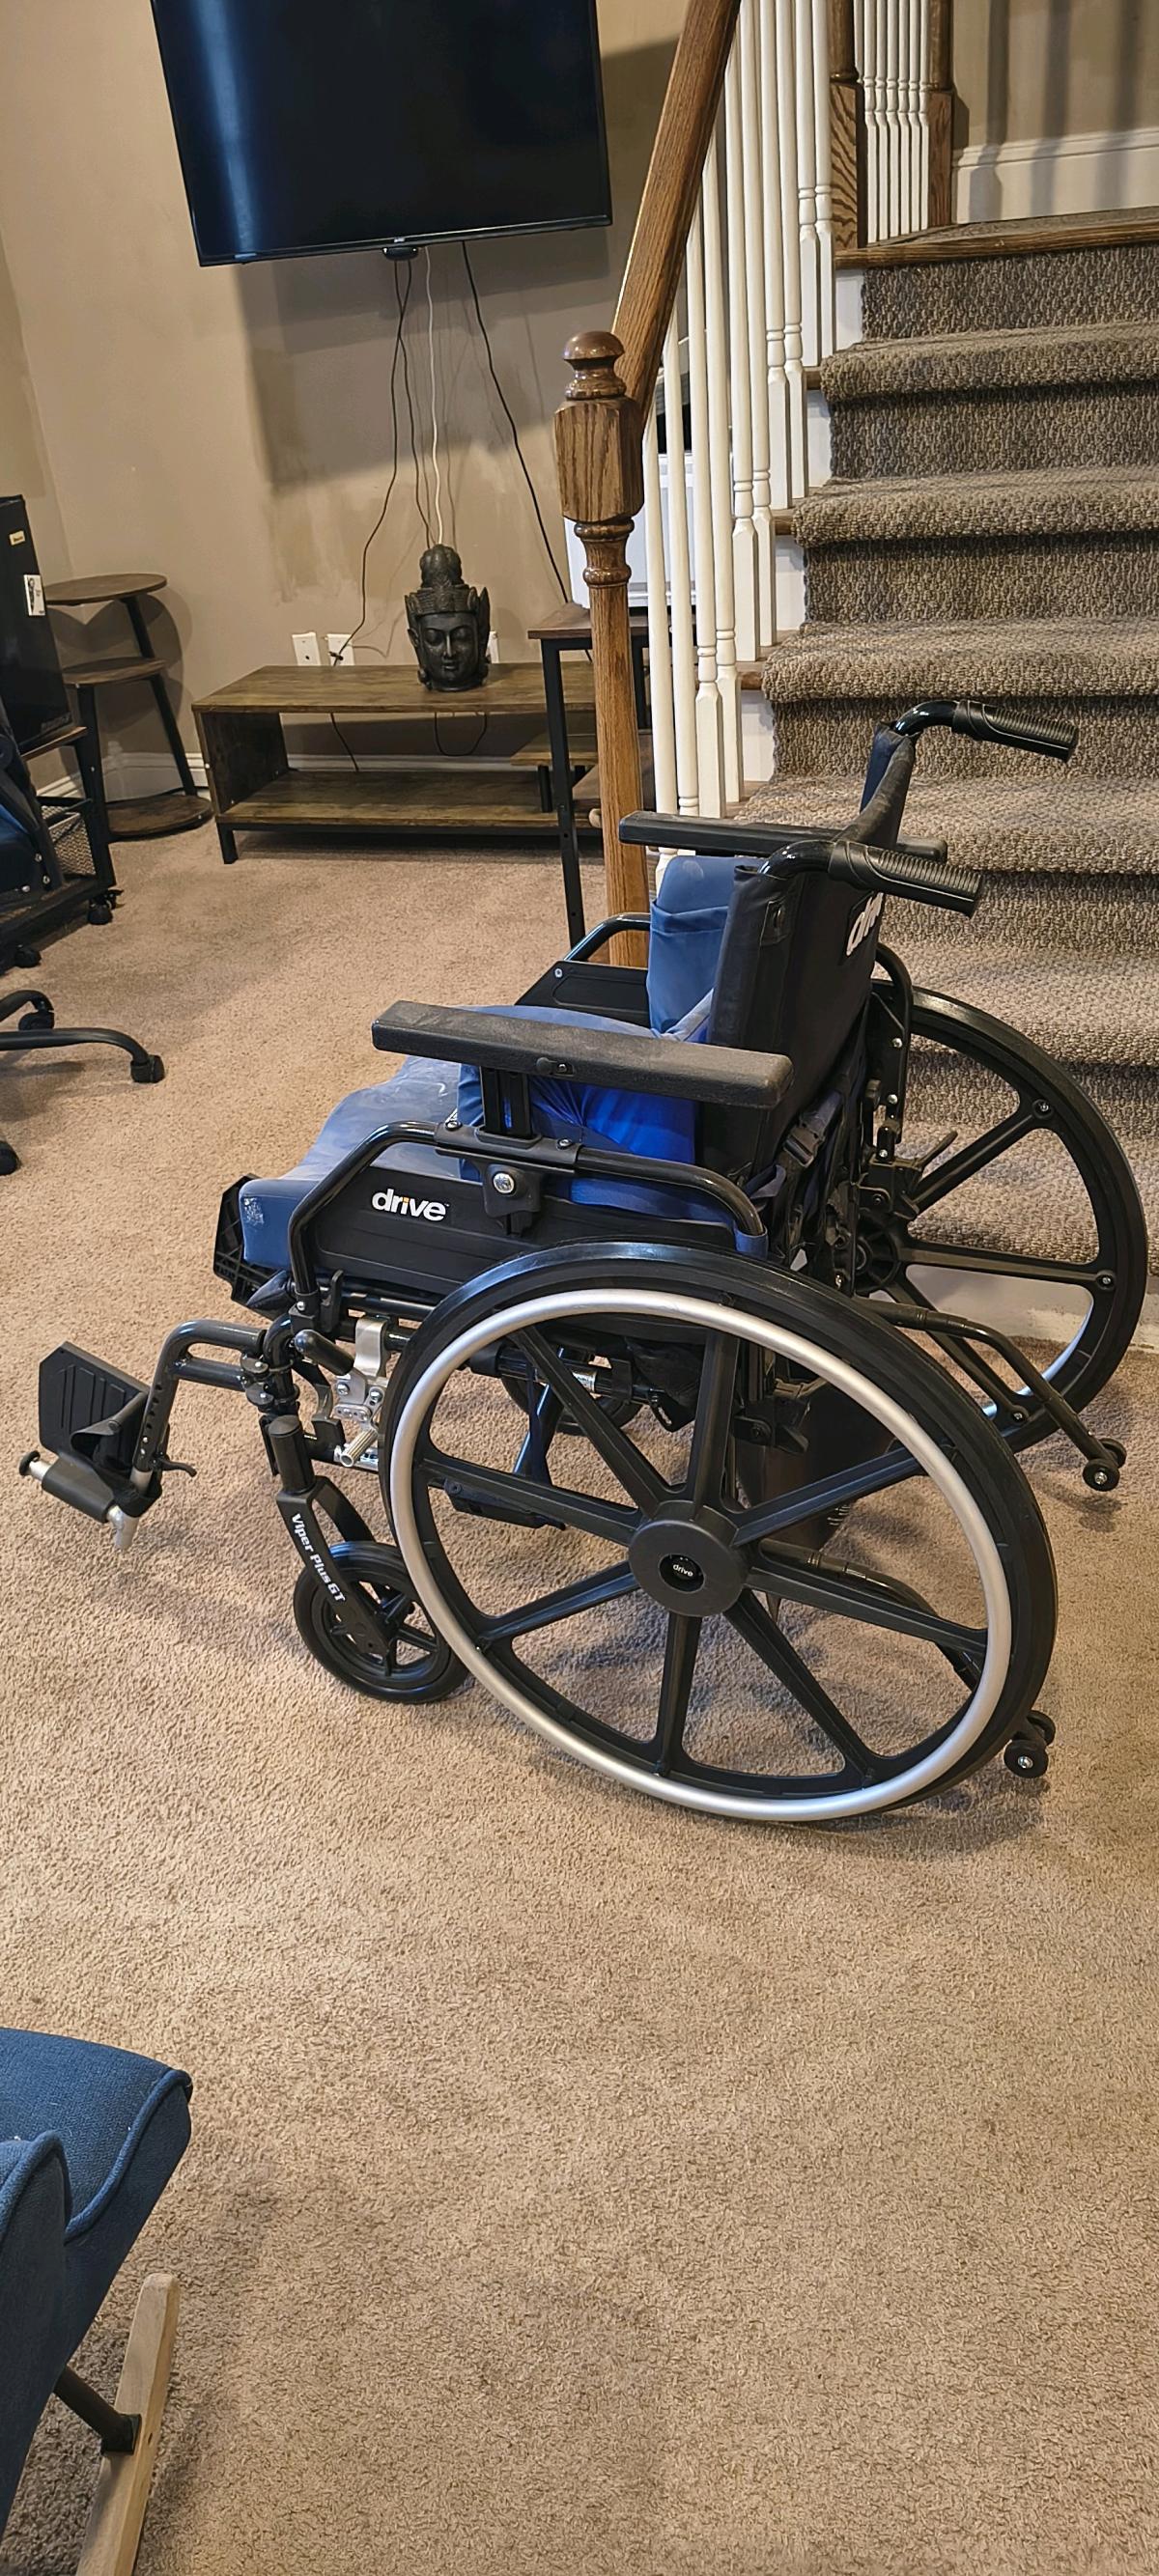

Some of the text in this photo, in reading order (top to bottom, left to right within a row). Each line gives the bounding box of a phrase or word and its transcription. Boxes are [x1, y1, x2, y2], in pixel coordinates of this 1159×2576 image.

[371, 1188, 447, 1221] drive
[292, 1513, 314, 1553] Viper
[672, 1564, 693, 1577] drive
